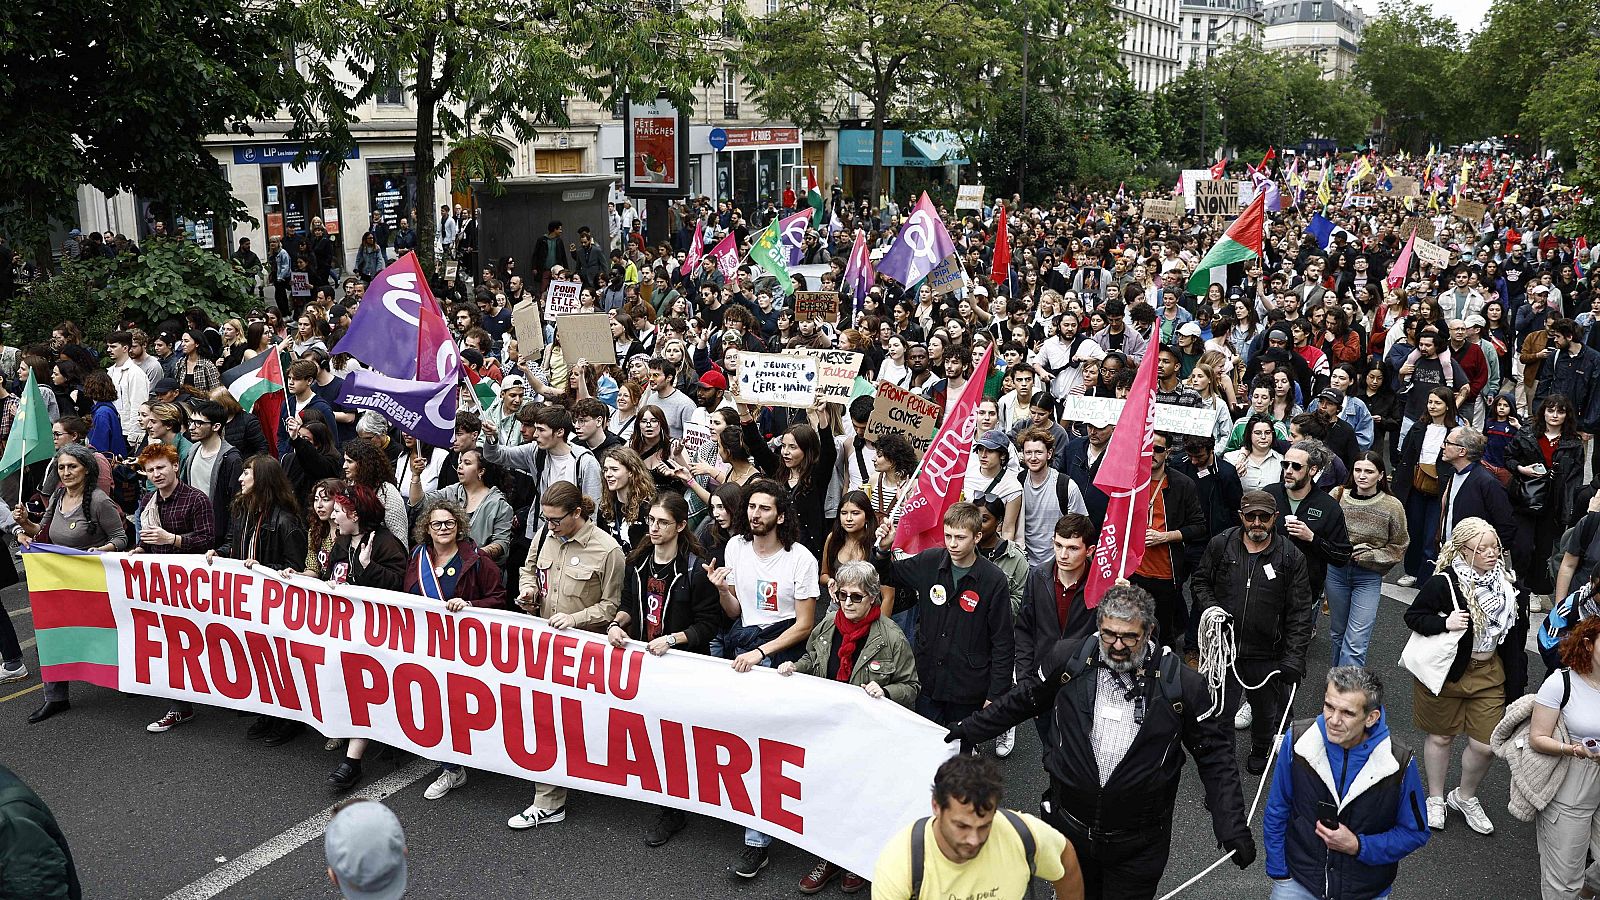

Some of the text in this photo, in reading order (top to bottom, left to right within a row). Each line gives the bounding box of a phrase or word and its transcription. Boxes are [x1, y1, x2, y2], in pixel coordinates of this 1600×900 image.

[634, 118, 654, 128] FÊTE
[758, 130, 771, 141] ROUES
[263, 148, 277, 157] LIP
[1196, 196, 1238, 214] NON!!
[934, 268, 950, 278] PIPI
[554, 284, 577, 294] POUR
[551, 296, 575, 307] ET LE
[550, 304, 574, 313] CLIMAT
[744, 360, 806, 371] LA JEUNESSE
[755, 371, 798, 379] EMMERDE
[878, 382, 909, 404] FRONT
[1072, 396, 1097, 411] VOUS
[888, 406, 924, 429] CONTRE
[121, 559, 645, 701] MARCHE POUR UN NOUVEAU
[131, 608, 806, 834] FRONT POPULAIRE
